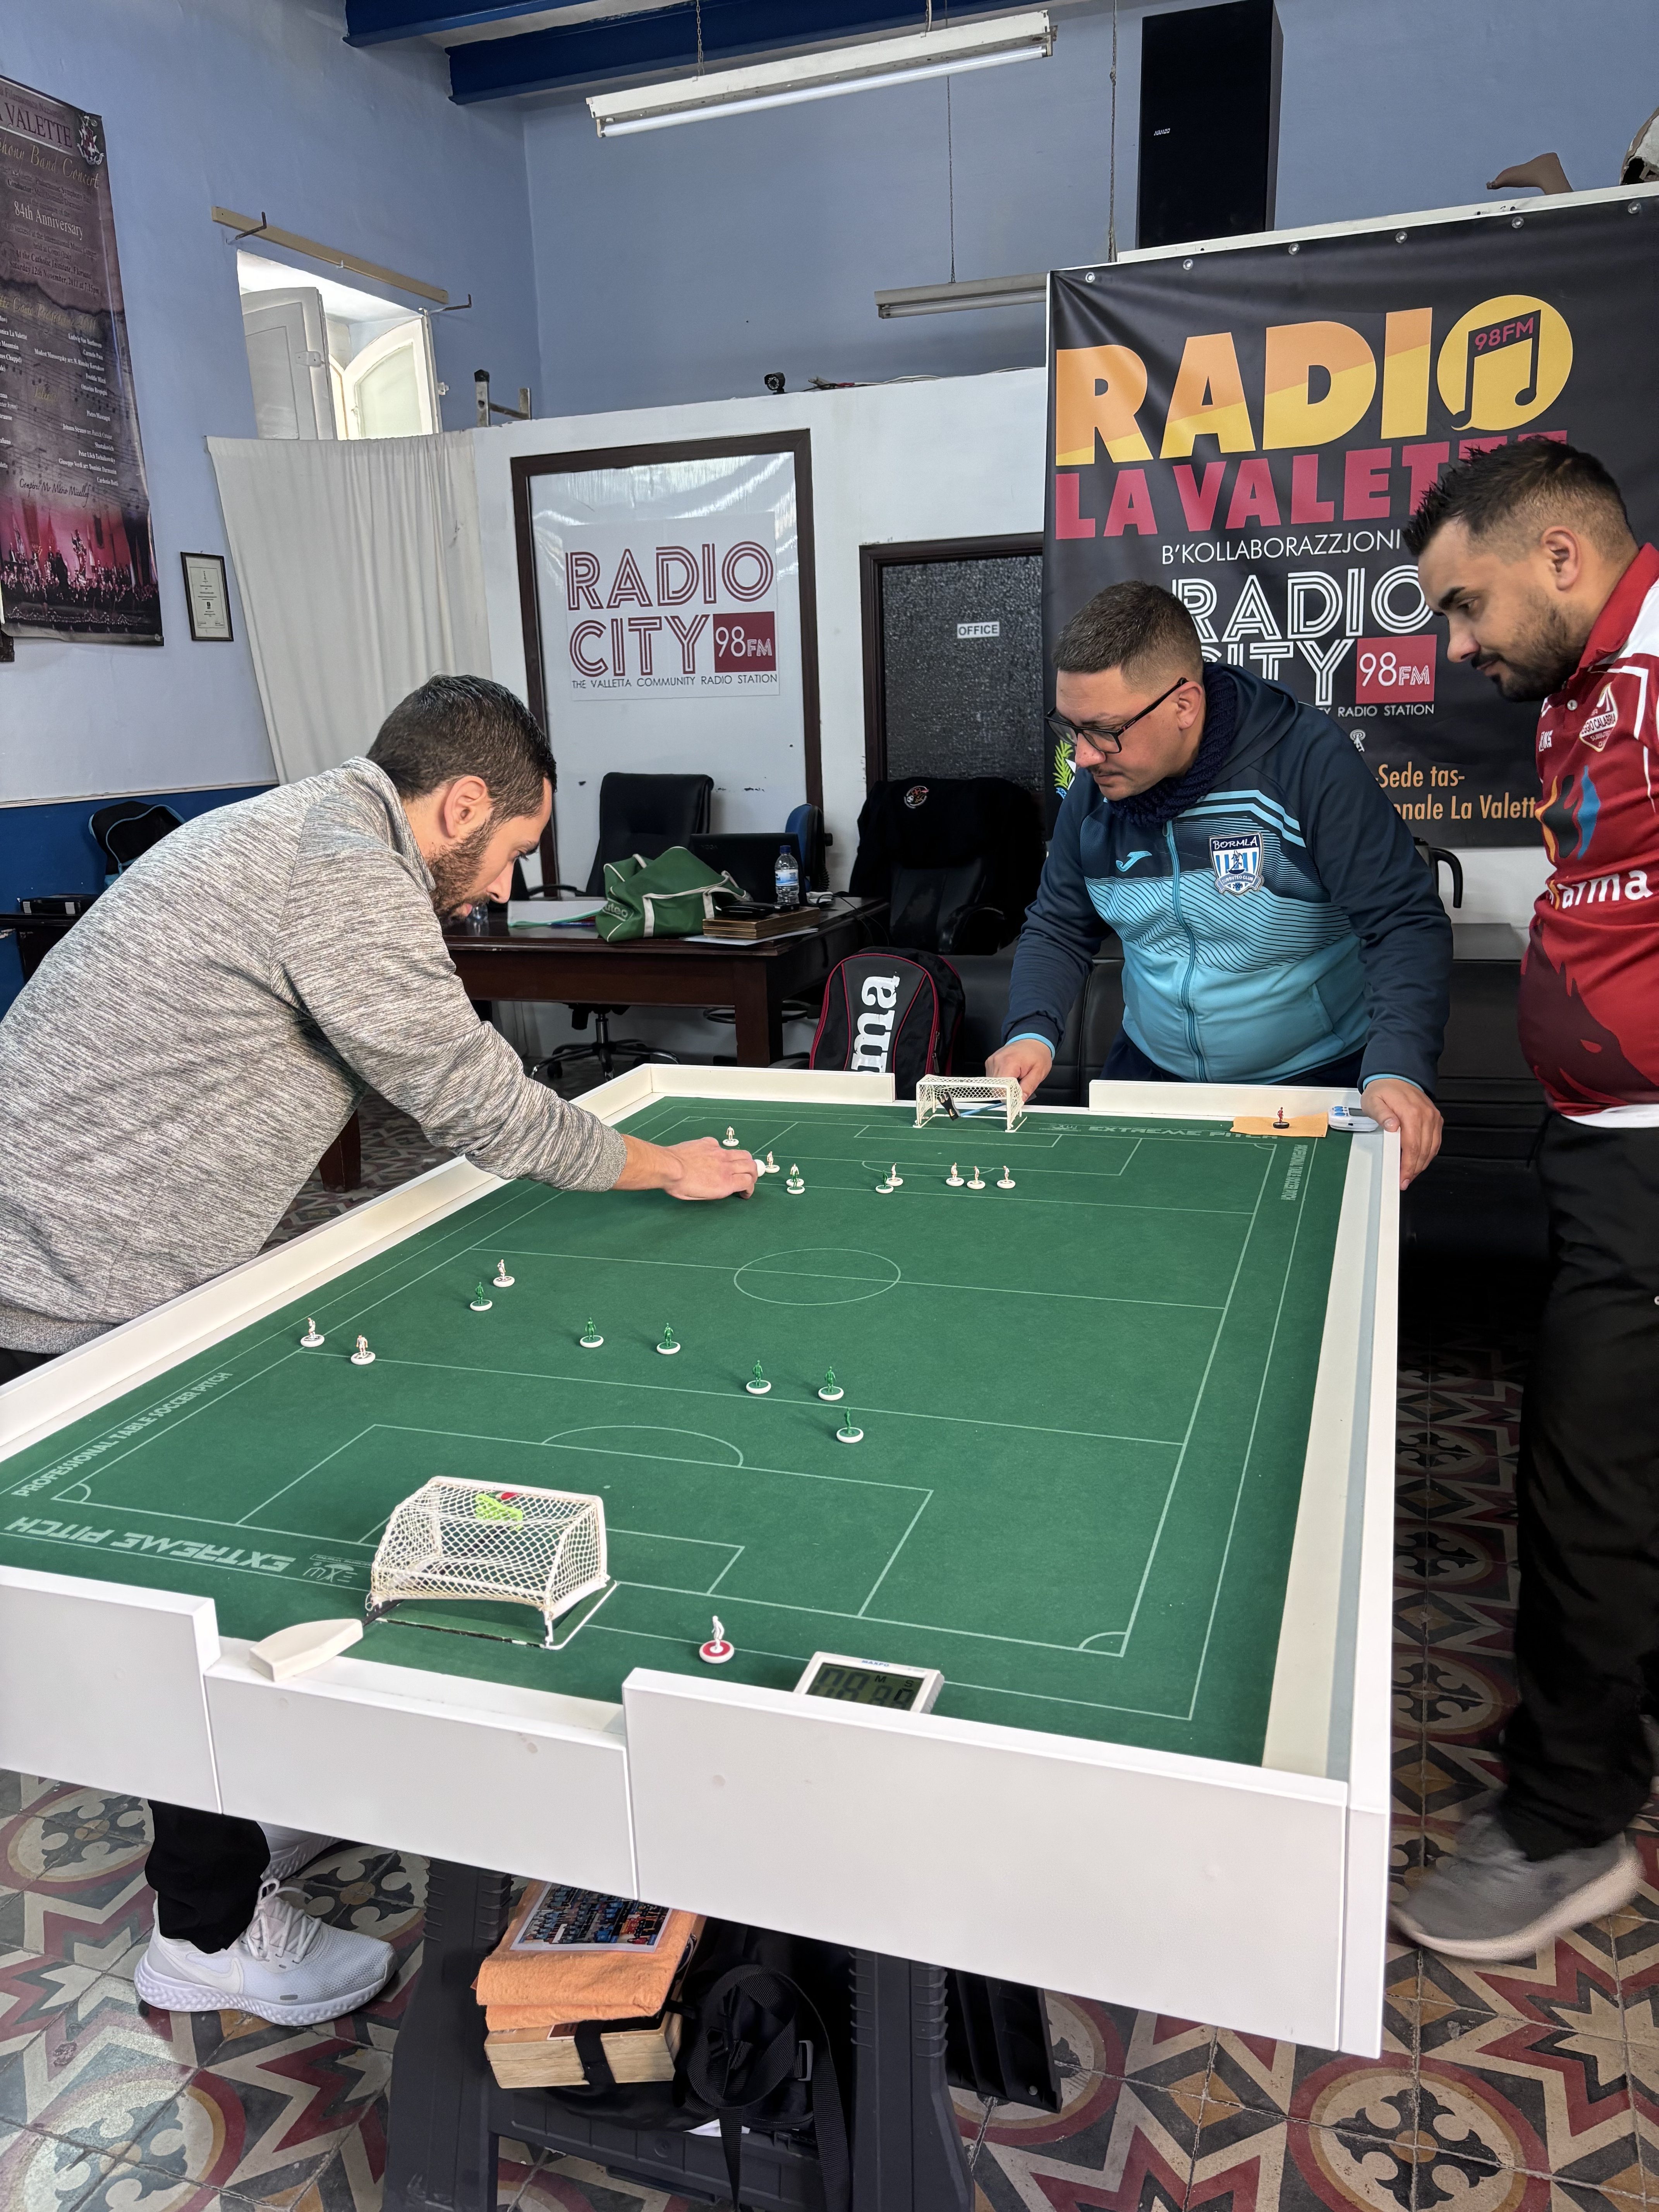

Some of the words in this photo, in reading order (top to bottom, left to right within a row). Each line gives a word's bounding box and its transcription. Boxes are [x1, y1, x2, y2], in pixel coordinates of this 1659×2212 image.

[5, 102, 72, 148] VALETTE
[63, 158, 100, 189] Concert
[14, 200, 33, 221] 84th
[36, 209, 83, 241] Anniversary
[1474, 315, 1535, 352] 98FM
[1056, 294, 1574, 466] RADIO
[1055, 469, 1158, 539] LA
[1174, 429, 1569, 532] VALET
[565, 541, 774, 611] RADIO
[1172, 564, 1434, 643] RADIO
[569, 614, 711, 677] CITY
[715, 626, 773, 658] 98FM
[958, 624, 998, 637] OFFICE
[572, 678, 586, 690] THE
[591, 677, 632, 689] VALLETTA
[637, 676, 696, 688] COMMUNITY
[701, 675, 733, 686] RADIO
[737, 673, 778, 685] STATION
[1359, 652, 1431, 687] 98FM
[1338, 706, 1378, 717] RADIO
[1384, 704, 1434, 716] STATION
[1431, 765, 1465, 787] tas-
[1451, 795, 1472, 820] La
[1480, 792, 1537, 819] Valett
[1212, 836, 1258, 850] BORMLA
[605, 903, 628, 918] uteo
[1088, 1126, 1202, 1136] EXTREME
[11, 1441, 119, 1498] PROFESSIONAL
[108, 1417, 157, 1442] TABLE
[149, 1389, 202, 1418] SOCCER
[192, 1372, 234, 1393] PITCH
[4, 1516, 115, 1544] PITCH
[111, 1532, 297, 1573] EXTREME
[874, 1675, 887, 1683] M
[904, 1680, 914, 1688] S
